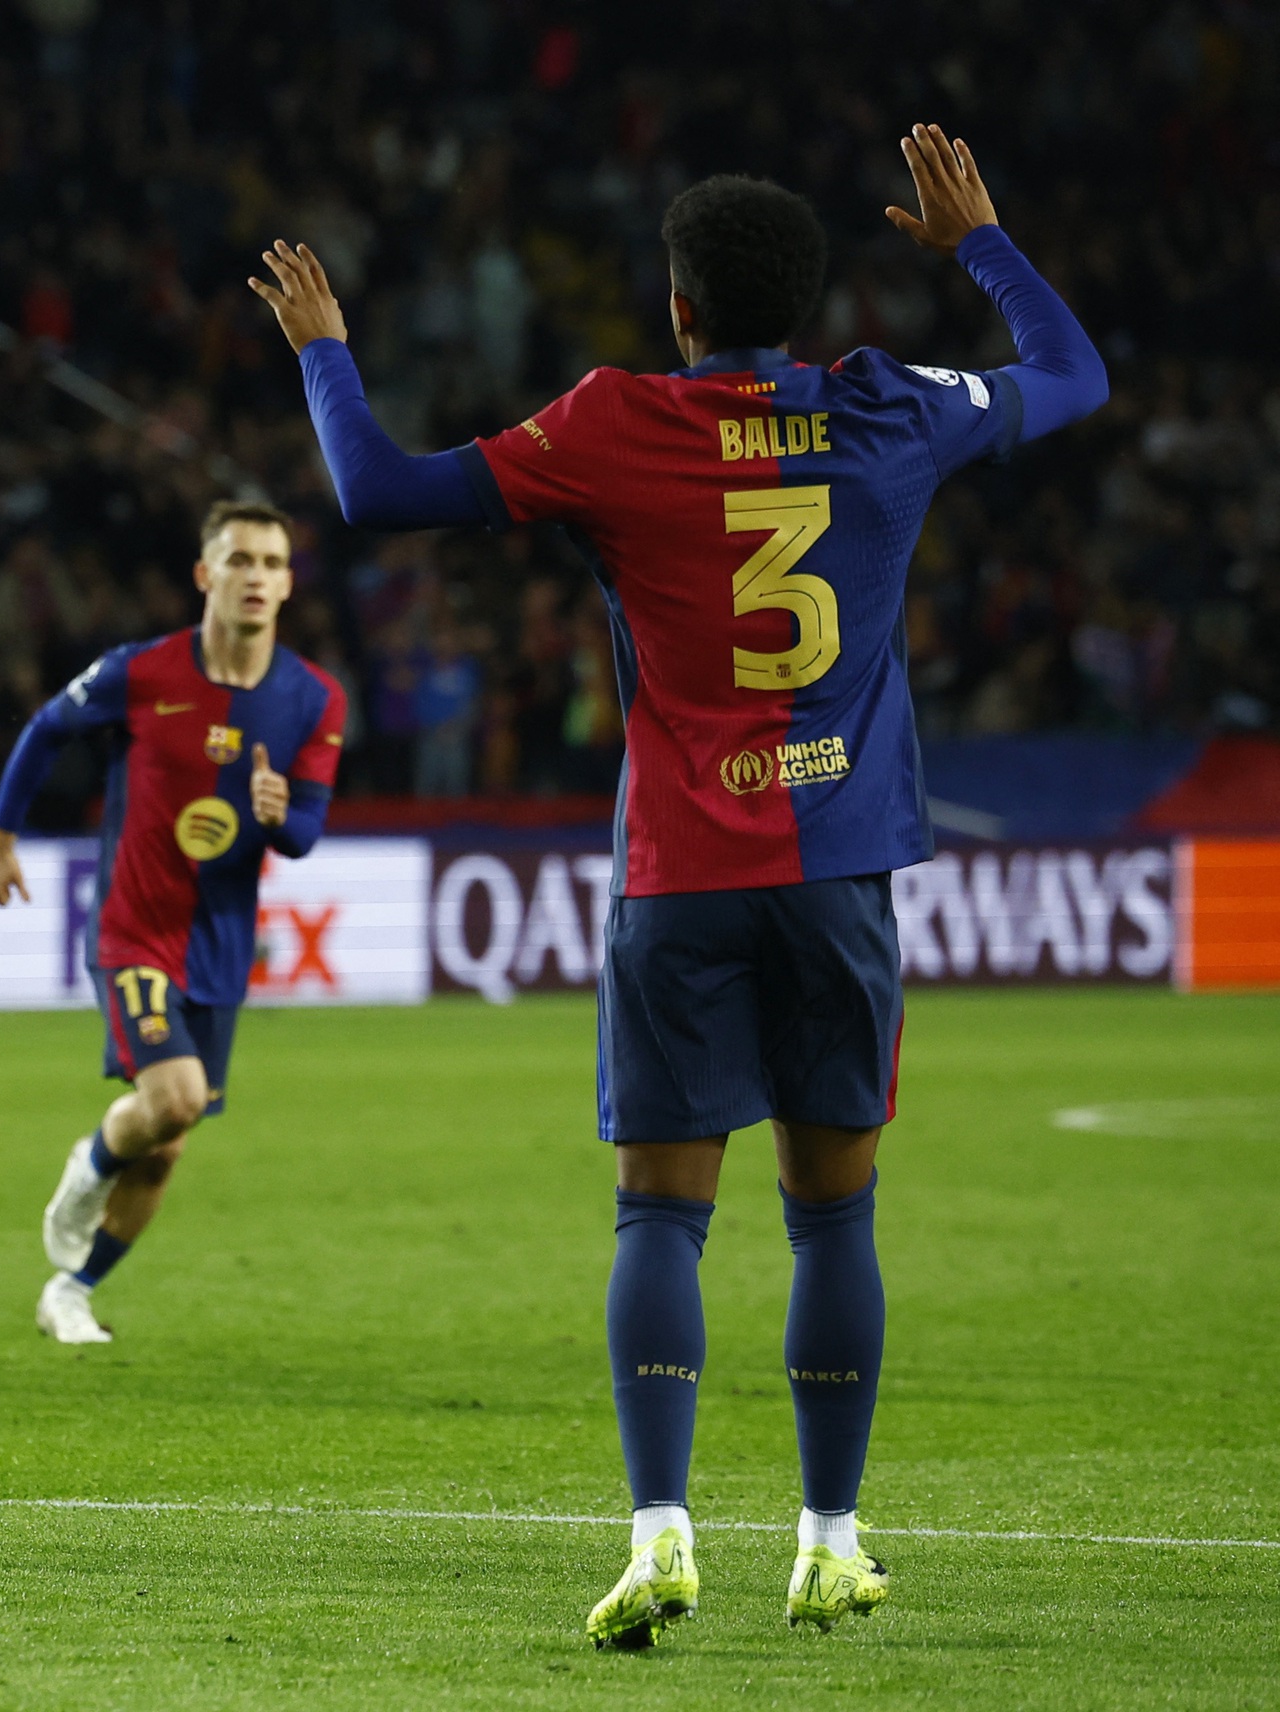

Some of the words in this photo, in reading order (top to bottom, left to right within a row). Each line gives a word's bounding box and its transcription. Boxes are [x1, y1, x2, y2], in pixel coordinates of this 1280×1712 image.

[719, 412, 831, 461] BALDE
[723, 484, 841, 691] 3
[776, 736, 846, 763] UNHCR
[778, 754, 851, 781] ACNUR
[114, 964, 170, 1019] 17
